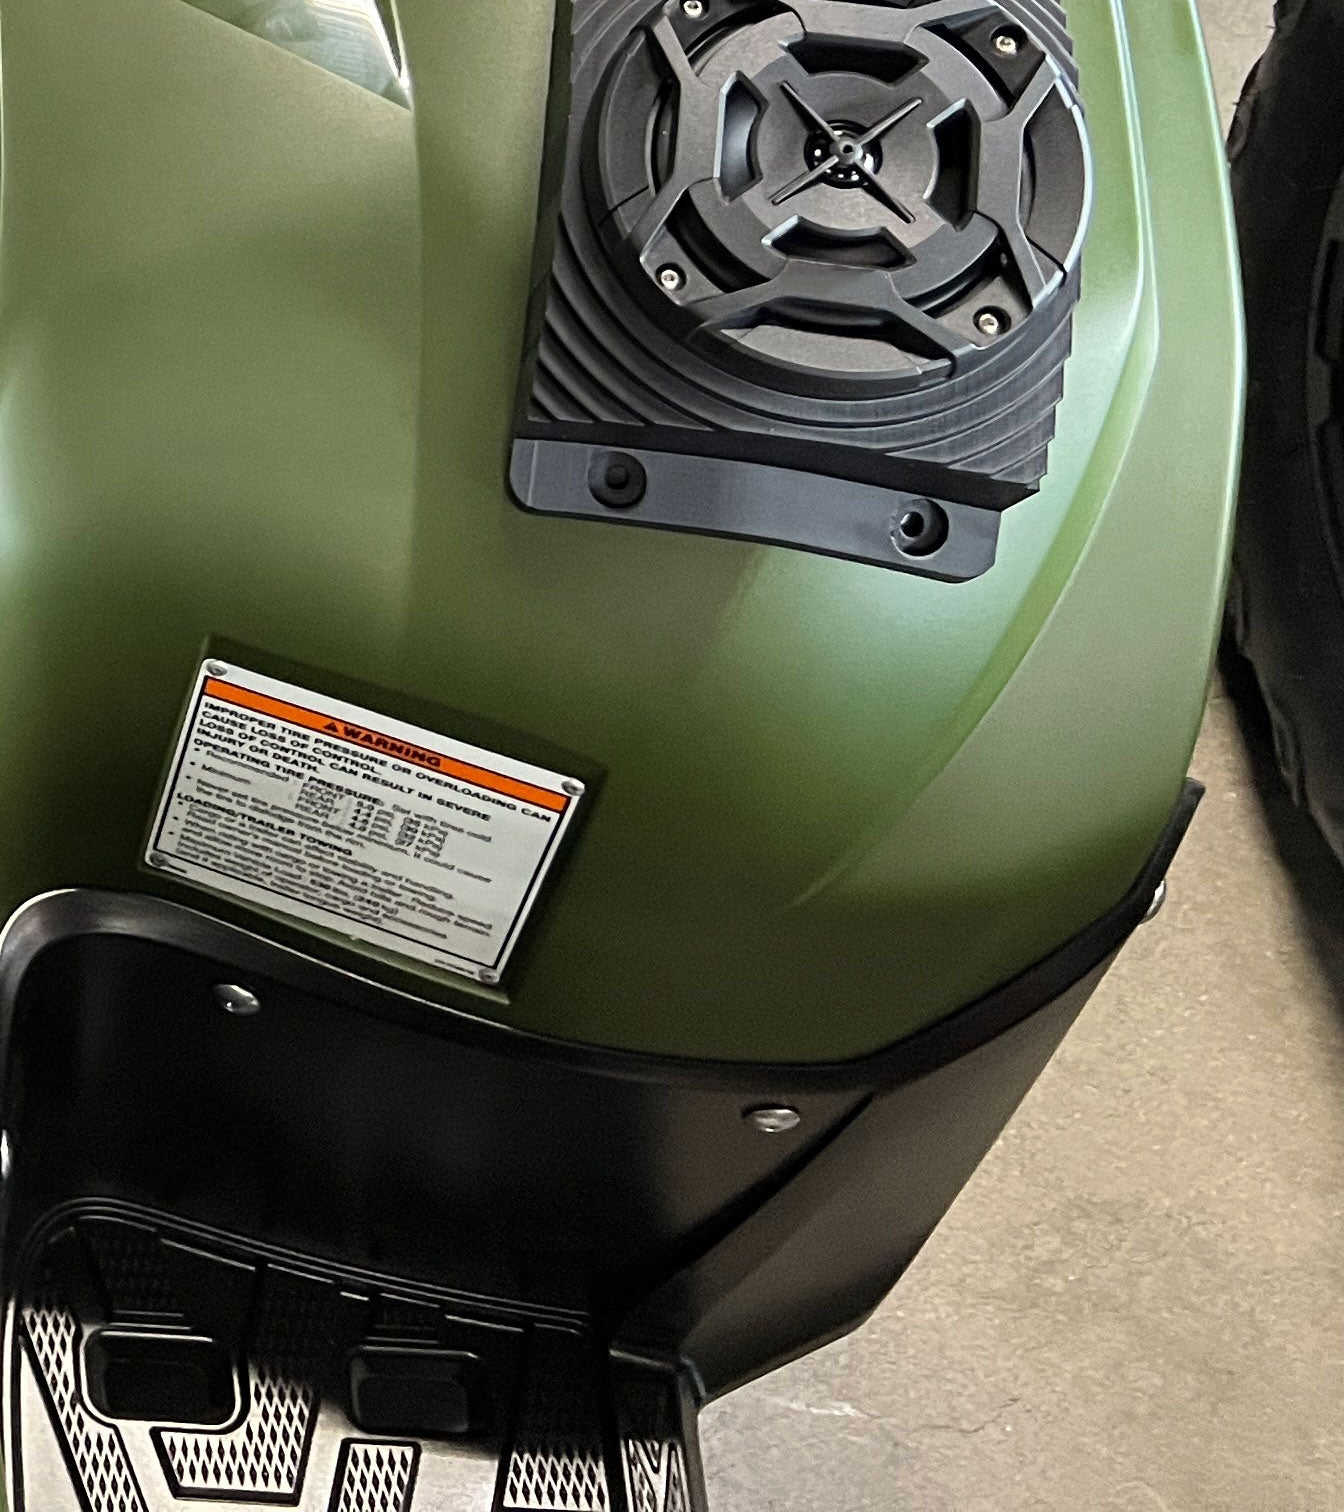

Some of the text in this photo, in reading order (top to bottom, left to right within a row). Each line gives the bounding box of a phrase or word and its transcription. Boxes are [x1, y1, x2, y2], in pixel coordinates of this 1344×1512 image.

[196, 726, 245, 748] INJURY
[201, 709, 247, 730] CAUSE
[250, 725, 286, 744] LOSS
[289, 739, 308, 751] OF
[341, 725, 442, 767] WARNING
[193, 736, 271, 769] OPERATING
[198, 718, 491, 821] LOSS OF CONTROL CAN RESULT IN SEVERE
[204, 700, 276, 730] IMPROPER
[279, 725, 310, 741] TIRE
[313, 737, 387, 767] PRESSURE
[414, 771, 518, 811] OVERLOADING
[519, 807, 551, 822] CAN
[298, 832, 353, 856] TOWING
